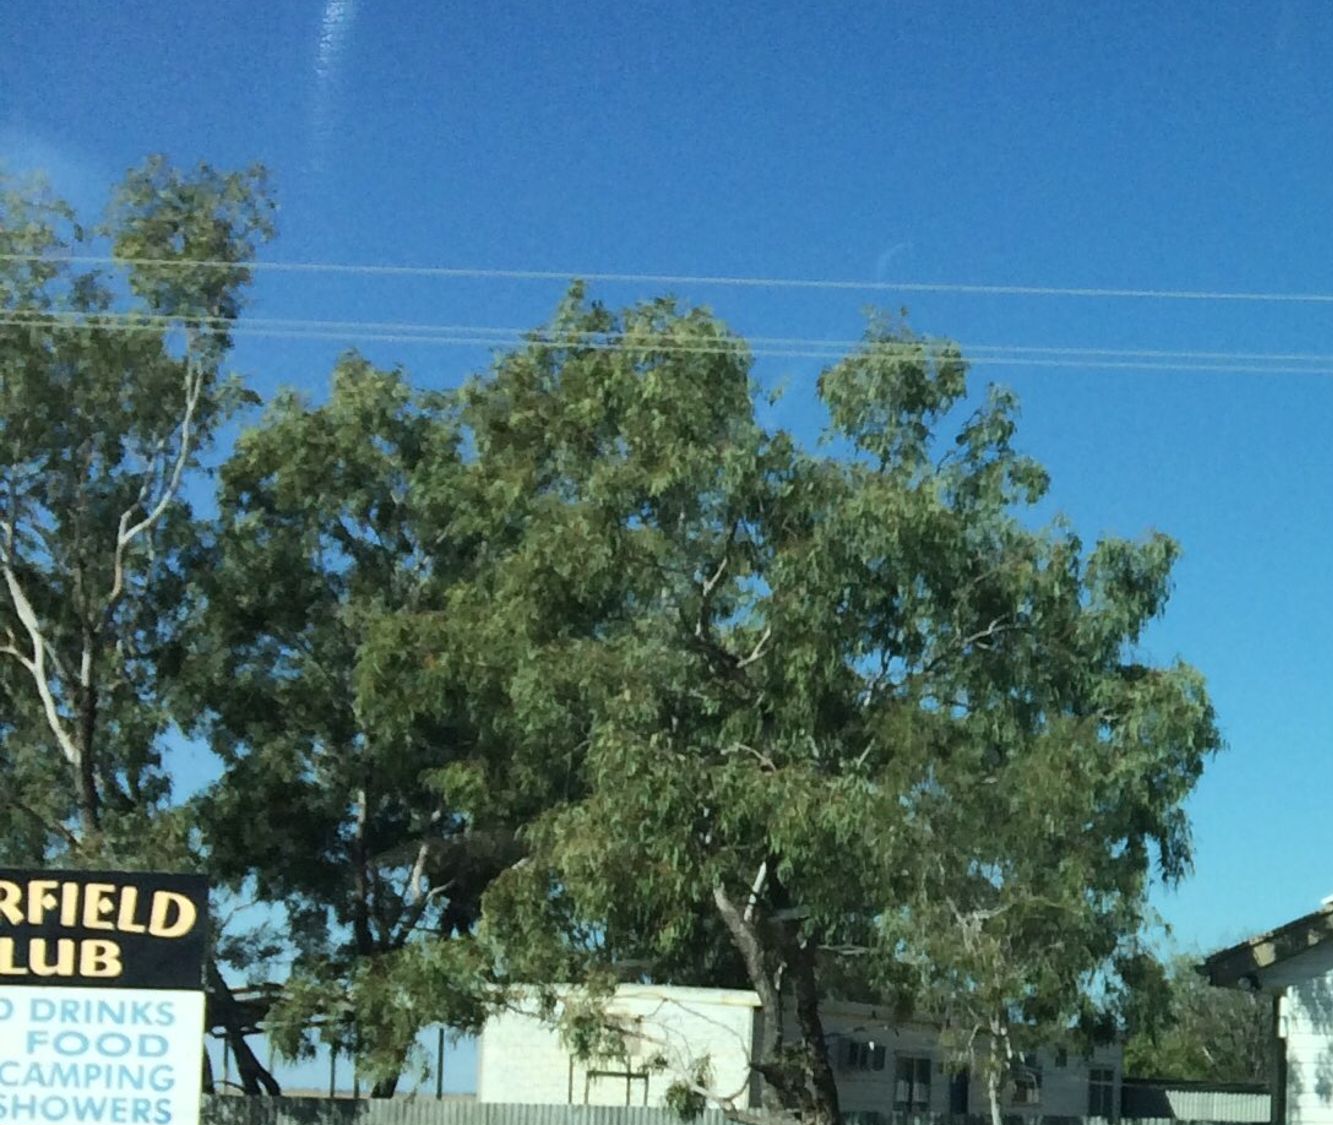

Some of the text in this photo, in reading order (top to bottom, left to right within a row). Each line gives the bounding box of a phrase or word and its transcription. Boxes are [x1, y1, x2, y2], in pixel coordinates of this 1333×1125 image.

[29, 998, 176, 1027] DRINKS
[26, 1031, 169, 1058] FOOD
[0, 1060, 176, 1093] CAMPING
